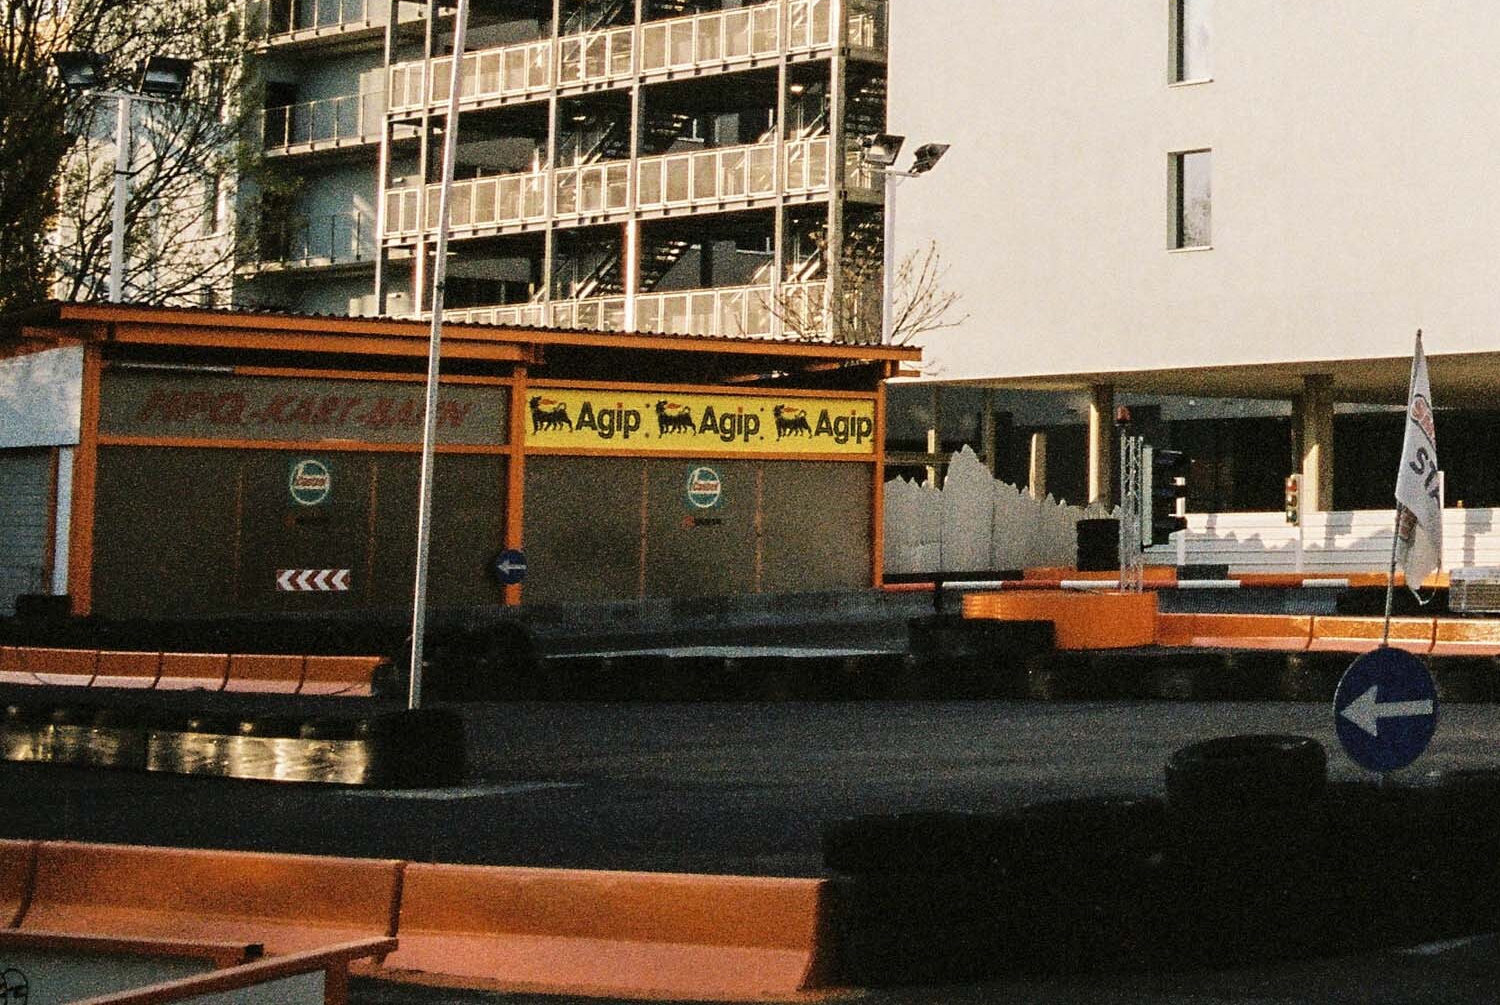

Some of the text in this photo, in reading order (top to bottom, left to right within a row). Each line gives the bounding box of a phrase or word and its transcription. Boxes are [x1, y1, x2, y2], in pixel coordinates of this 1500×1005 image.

[575, 401, 873, 445] Agip Agip Agip
